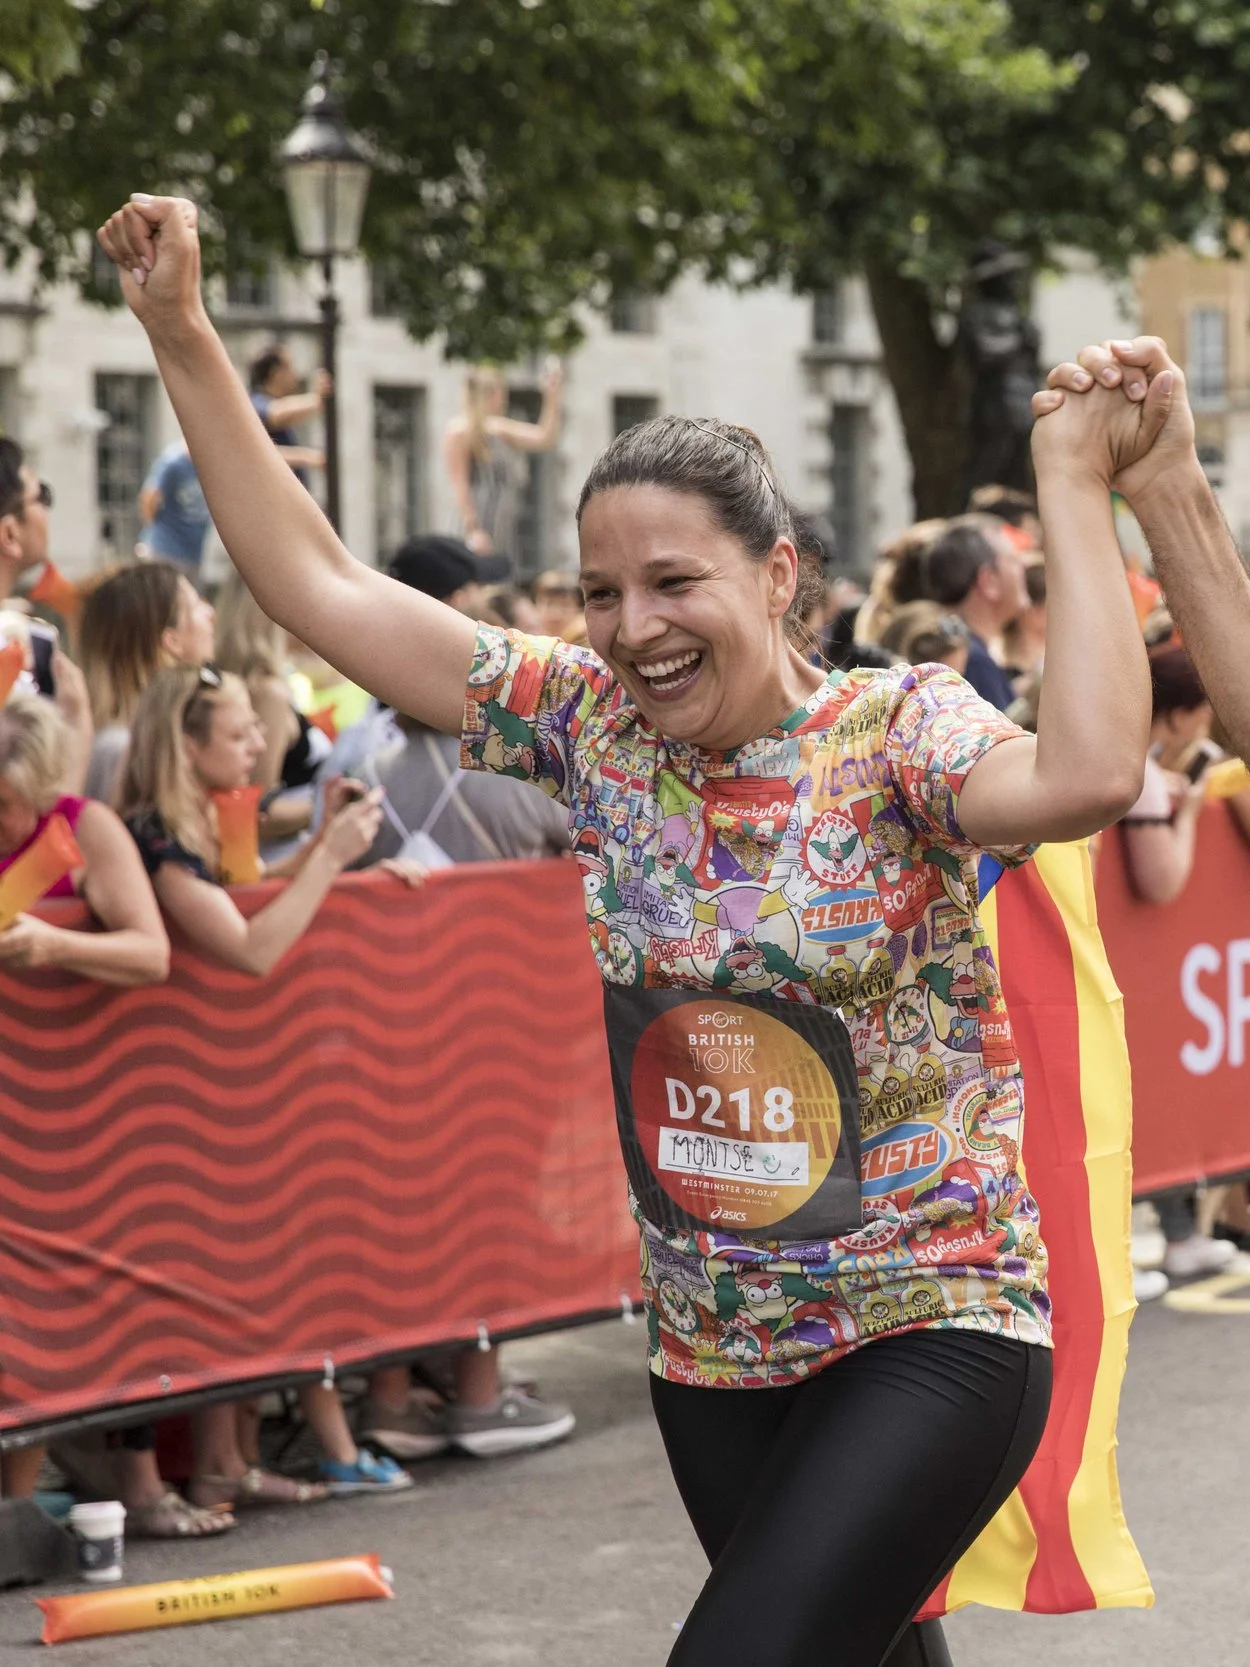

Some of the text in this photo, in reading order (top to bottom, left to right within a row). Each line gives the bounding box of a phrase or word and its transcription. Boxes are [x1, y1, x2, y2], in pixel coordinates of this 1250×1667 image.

[820, 861, 863, 881] STUFF
[650, 928, 721, 967] Krusty
[858, 976, 894, 999] ACID
[697, 1011, 743, 1029] SPORT
[688, 1034, 755, 1046] BRITISH
[688, 1048, 756, 1074] 10K
[912, 1075, 945, 1093] SULFURIC
[915, 1083, 947, 1106] ACID
[665, 1077, 795, 1132] D218
[879, 1097, 912, 1120] ACID
[671, 1134, 754, 1172] MONTSE
[681, 1179, 778, 1198] WESTMINSTER 09.07.17
[722, 1210, 746, 1222] asics
[917, 1230, 985, 1265] KrustyO's
